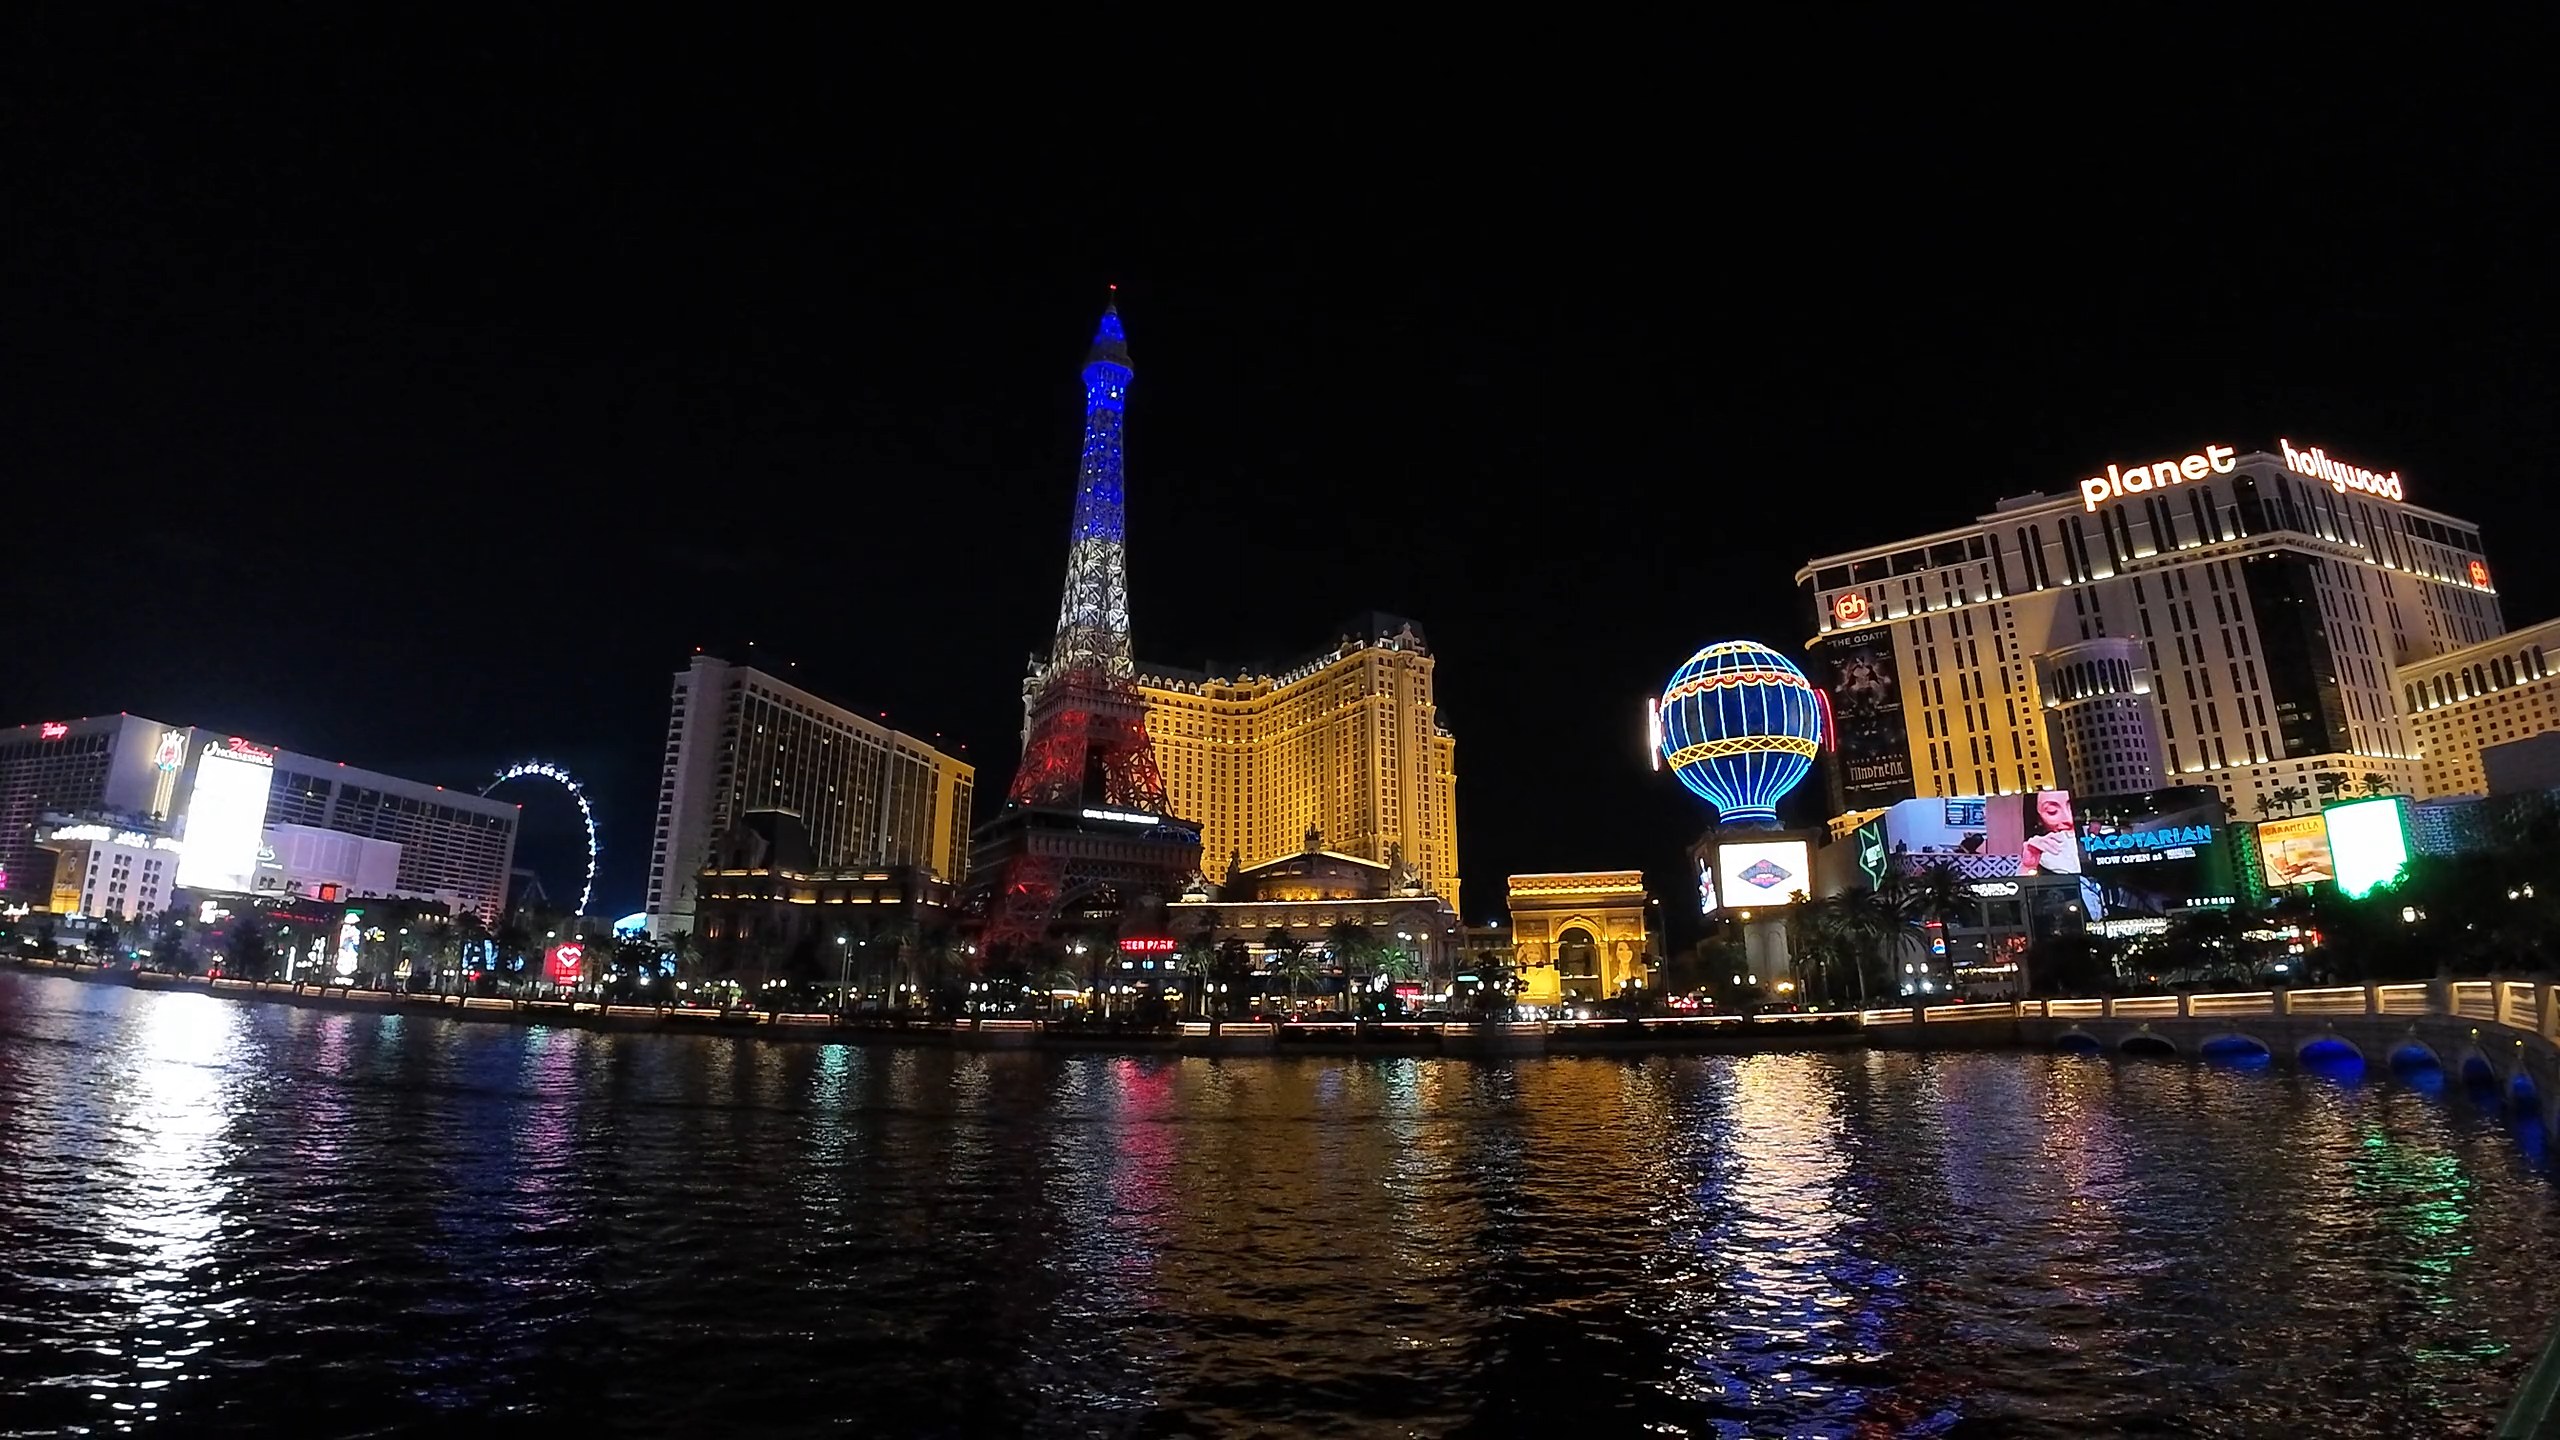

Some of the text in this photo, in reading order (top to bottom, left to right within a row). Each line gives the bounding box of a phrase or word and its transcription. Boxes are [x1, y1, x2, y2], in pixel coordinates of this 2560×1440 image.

[2081, 440, 2403, 512] planet hollywood
[1840, 594, 1865, 618] ph
[2080, 825, 2212, 852] TACOTARIAN
[2096, 856, 2120, 865] NOW
[2122, 854, 2150, 863] OPEN
[2152, 853, 2163, 861] at
[1147, 940, 1174, 950] PARK
